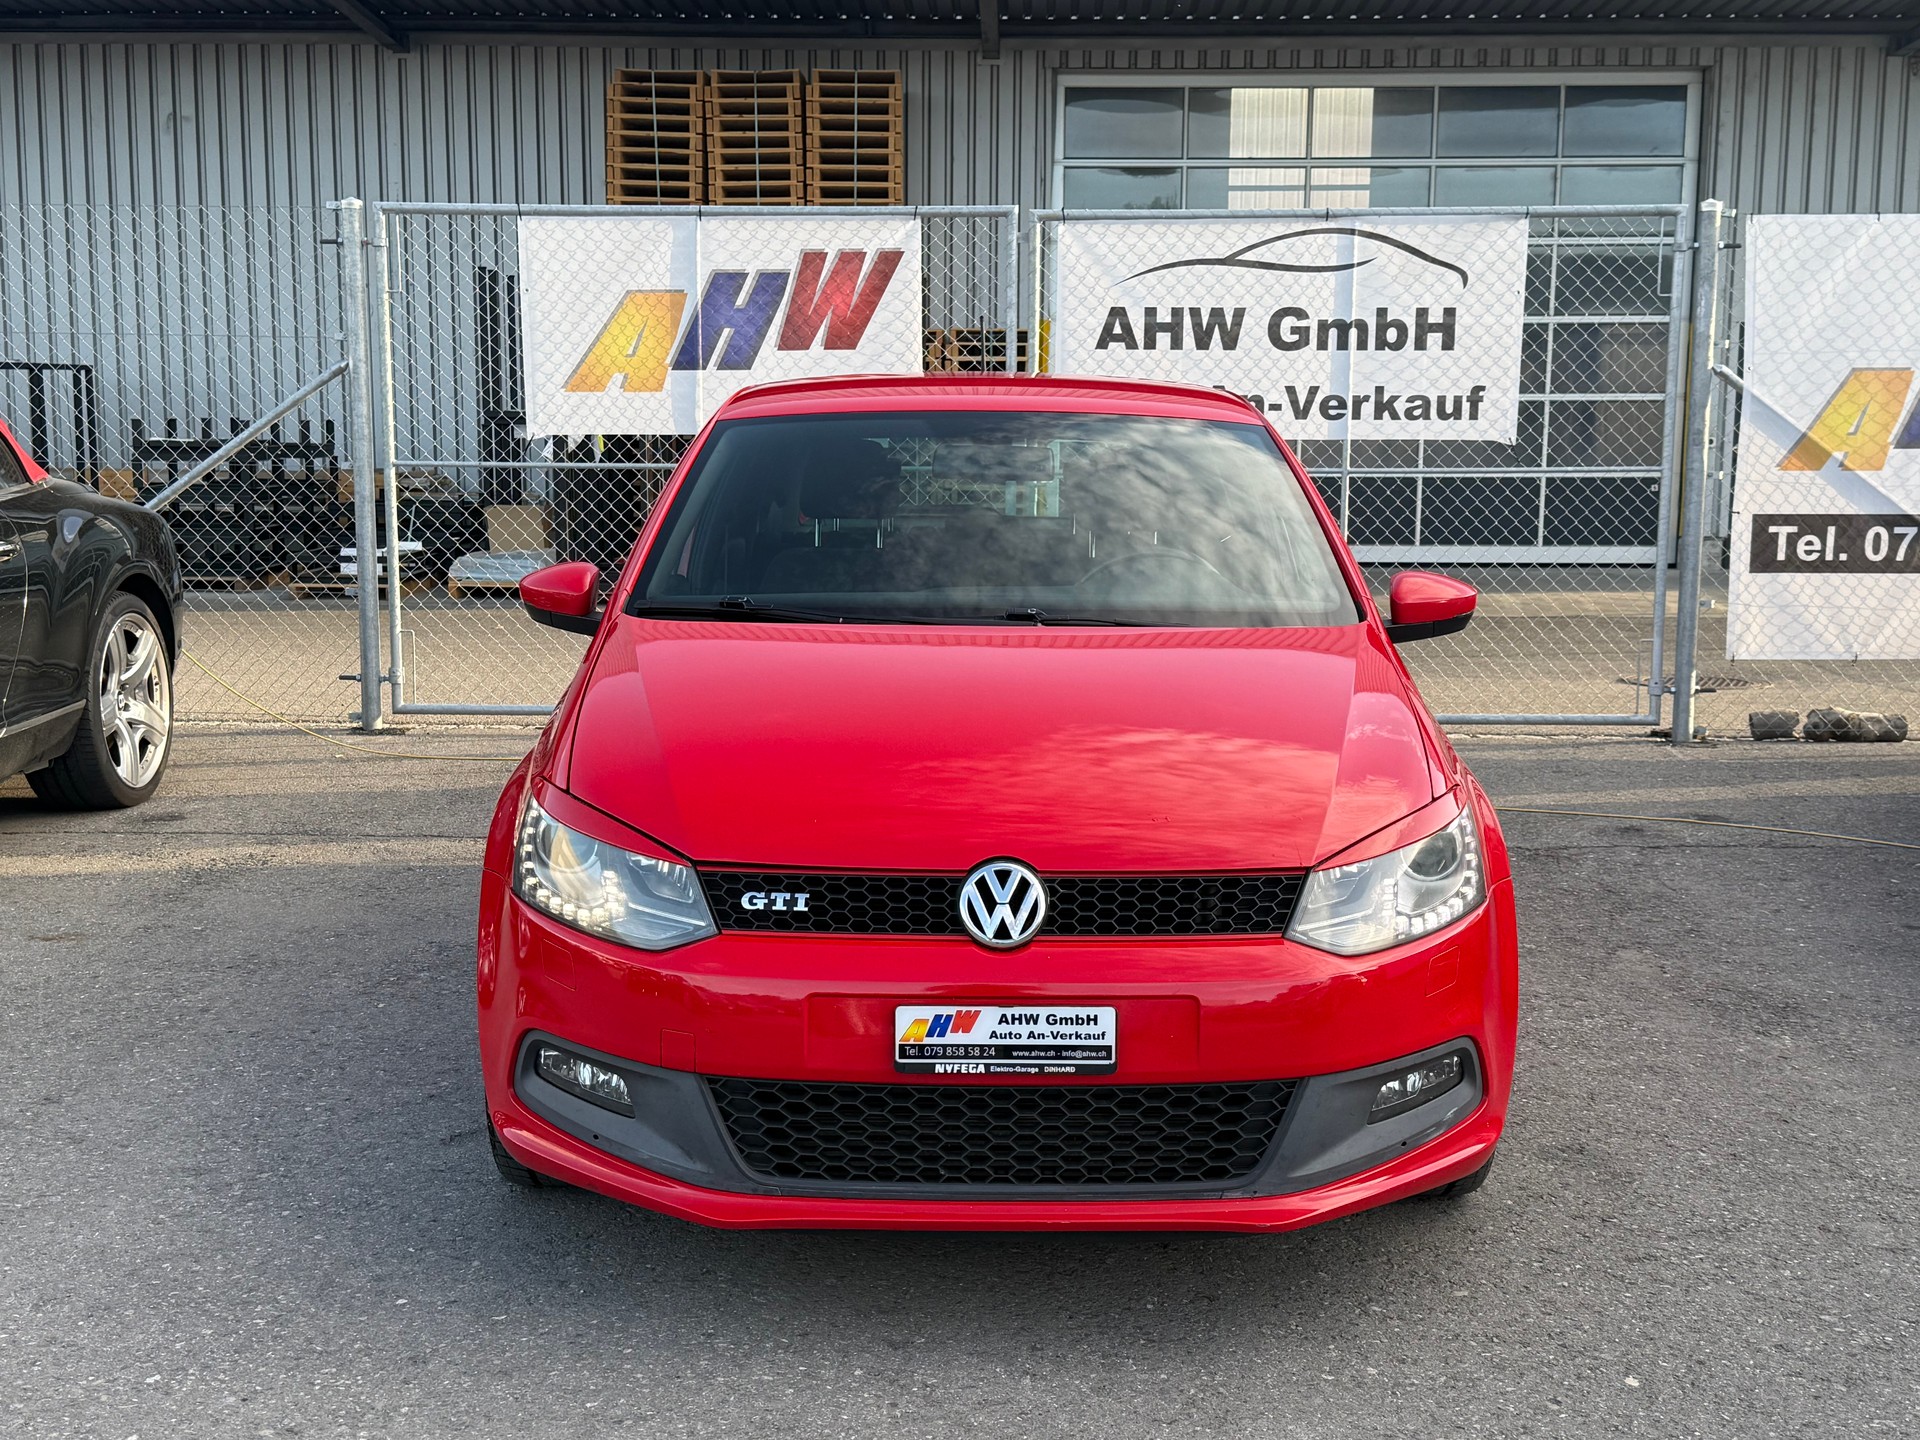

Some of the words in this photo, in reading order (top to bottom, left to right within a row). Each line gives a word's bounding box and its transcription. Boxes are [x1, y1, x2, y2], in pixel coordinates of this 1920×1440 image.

[562, 248, 904, 392] AHW
[1095, 306, 1246, 351] AHW
[1267, 306, 1456, 352] GmbH
[1775, 367, 1920, 471] A
[1768, 525, 1848, 562] Tel.
[1864, 525, 1918, 562] 07
[740, 891, 810, 912] GTI
[965, 868, 1040, 940] VW
[899, 1010, 982, 1042] AHW
[998, 1013, 1040, 1025] AHW
[1045, 1013, 1098, 1026] GmbH
[988, 1030, 1022, 1040] Auto
[1026, 1030, 1107, 1040] An-Verkauf
[904, 1046, 921, 1056] Tel.
[924, 1046, 943, 1056] 079
[945, 1046, 965, 1056] 858
[968, 1046, 980, 1056] 58
[983, 1046, 996, 1056] 24
[1062, 1050, 1107, 1058] info@ahw.ch
[934, 1063, 986, 1074] NYFEGA
